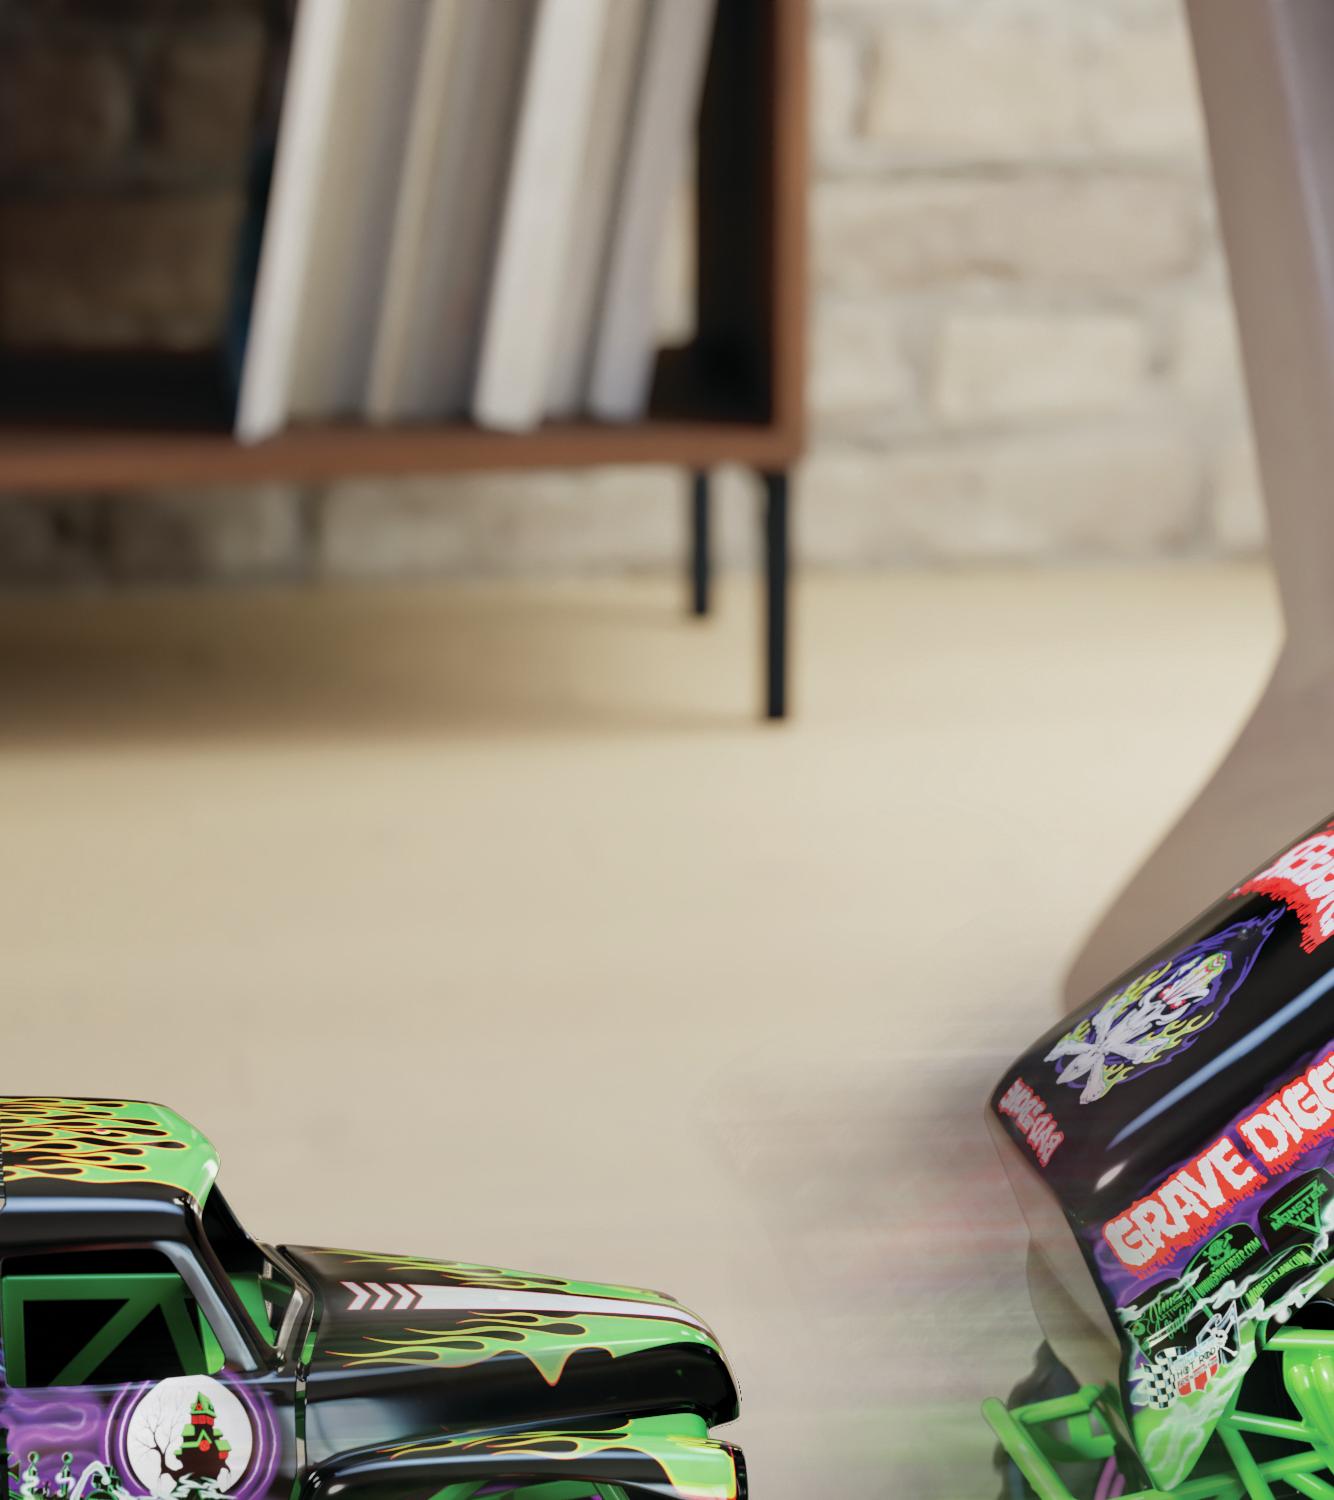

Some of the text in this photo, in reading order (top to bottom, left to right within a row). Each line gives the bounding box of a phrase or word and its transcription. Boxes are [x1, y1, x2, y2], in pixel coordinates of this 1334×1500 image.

[1105, 1137, 1259, 1267] GRAVE
[1270, 1183, 1328, 1232] MONSTER
[1295, 1201, 1320, 1227] JAM
